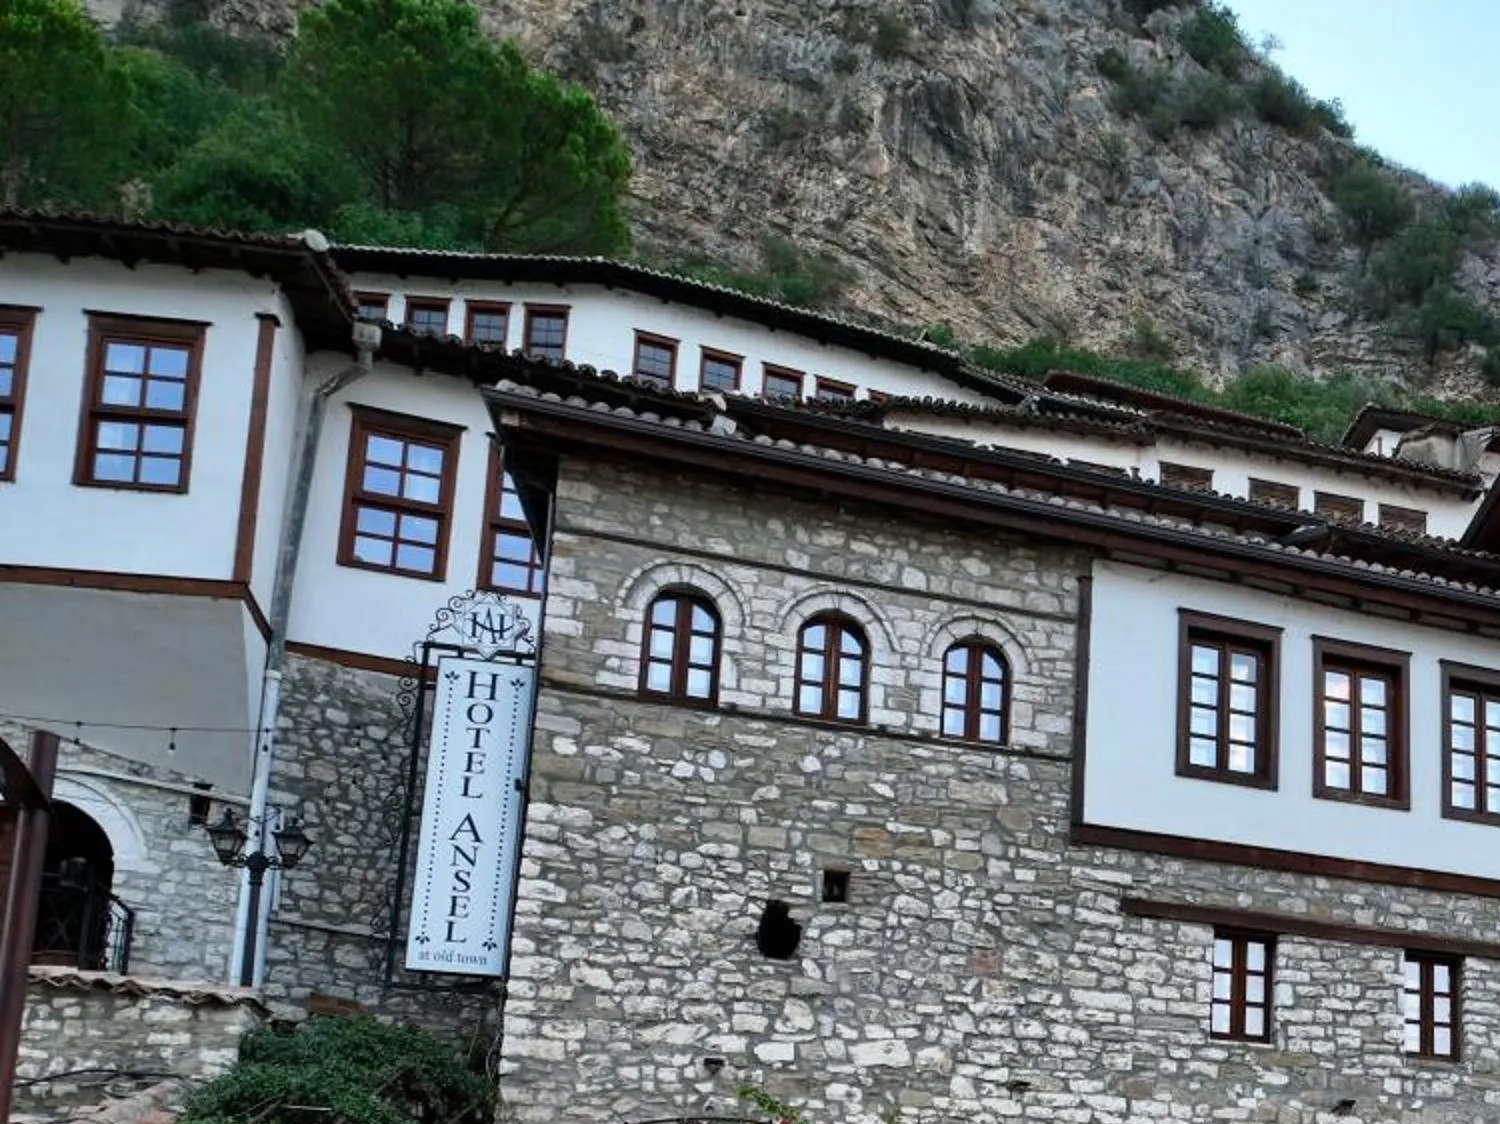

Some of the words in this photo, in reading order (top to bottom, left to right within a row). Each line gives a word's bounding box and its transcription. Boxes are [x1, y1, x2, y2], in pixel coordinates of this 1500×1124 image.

[460, 670, 504, 799] HOTEL
[445, 812, 485, 943] ANSEL
[433, 949, 453, 963] old
[457, 953, 487, 965] town
